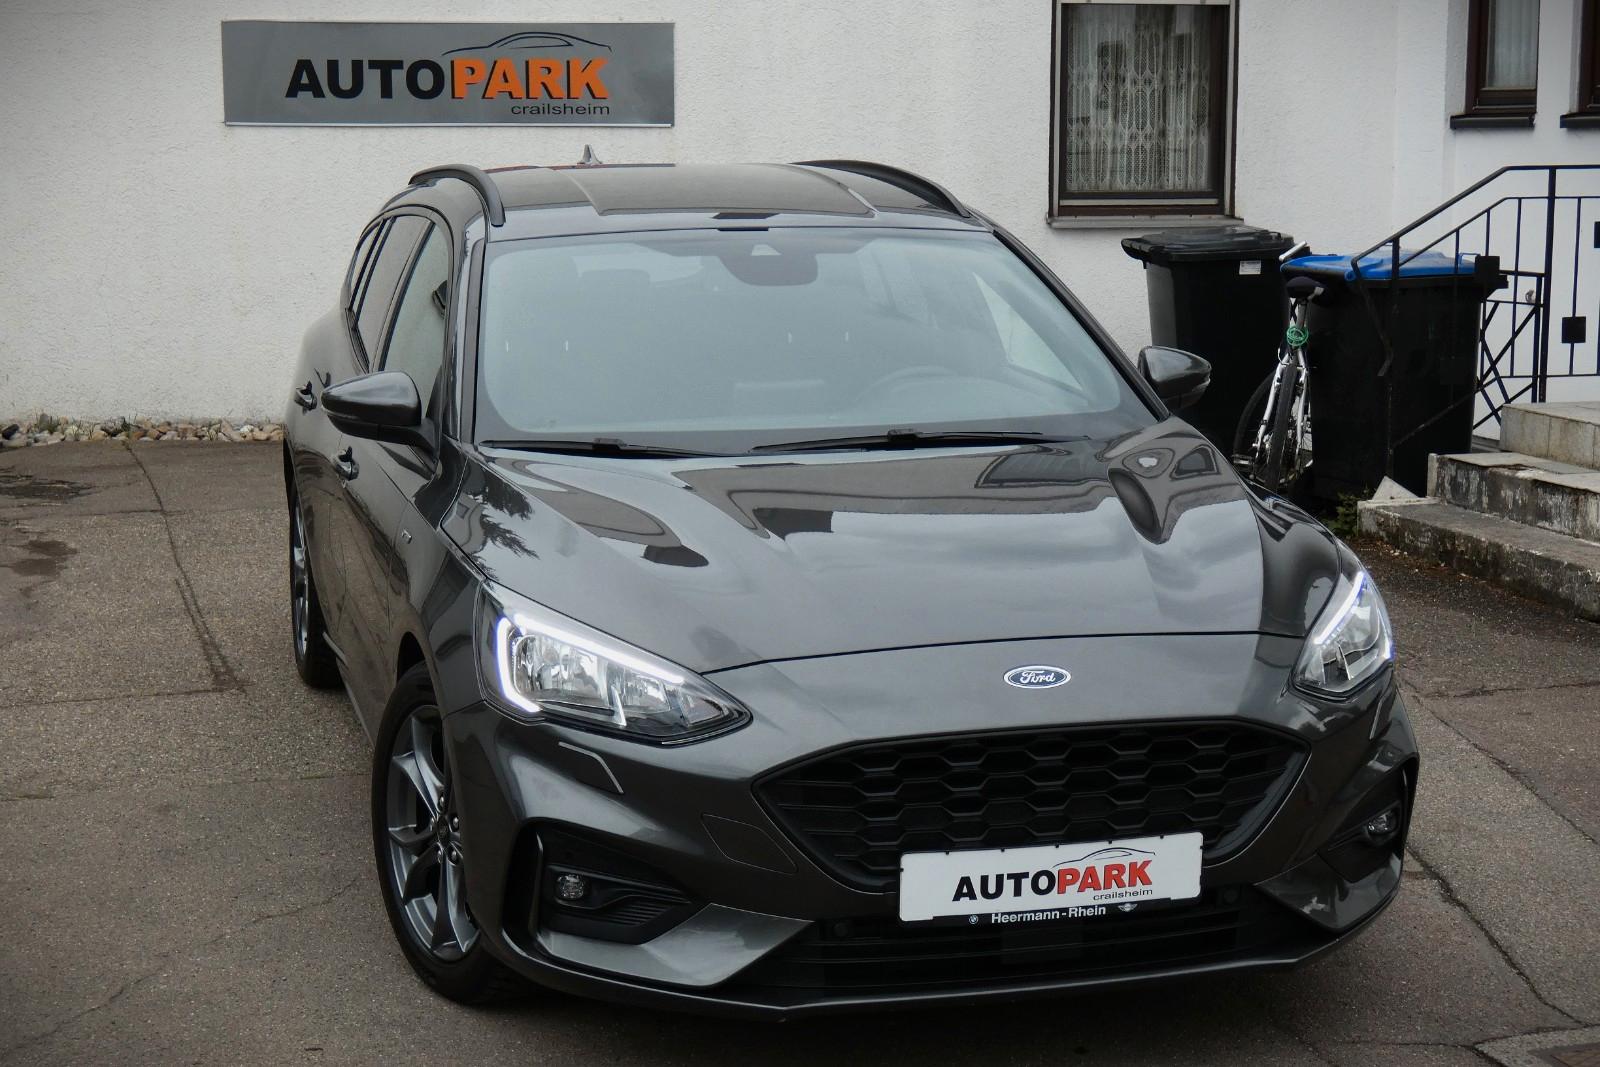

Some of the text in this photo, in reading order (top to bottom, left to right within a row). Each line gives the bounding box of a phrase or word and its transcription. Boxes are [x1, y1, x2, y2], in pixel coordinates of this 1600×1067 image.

[285, 58, 609, 100] AUTOPARK
[510, 102, 610, 116] crailsheim
[1019, 670, 1056, 684] Ford
[952, 860, 1153, 901] AUTOPARK
[1093, 888, 1153, 901] crailsheim
